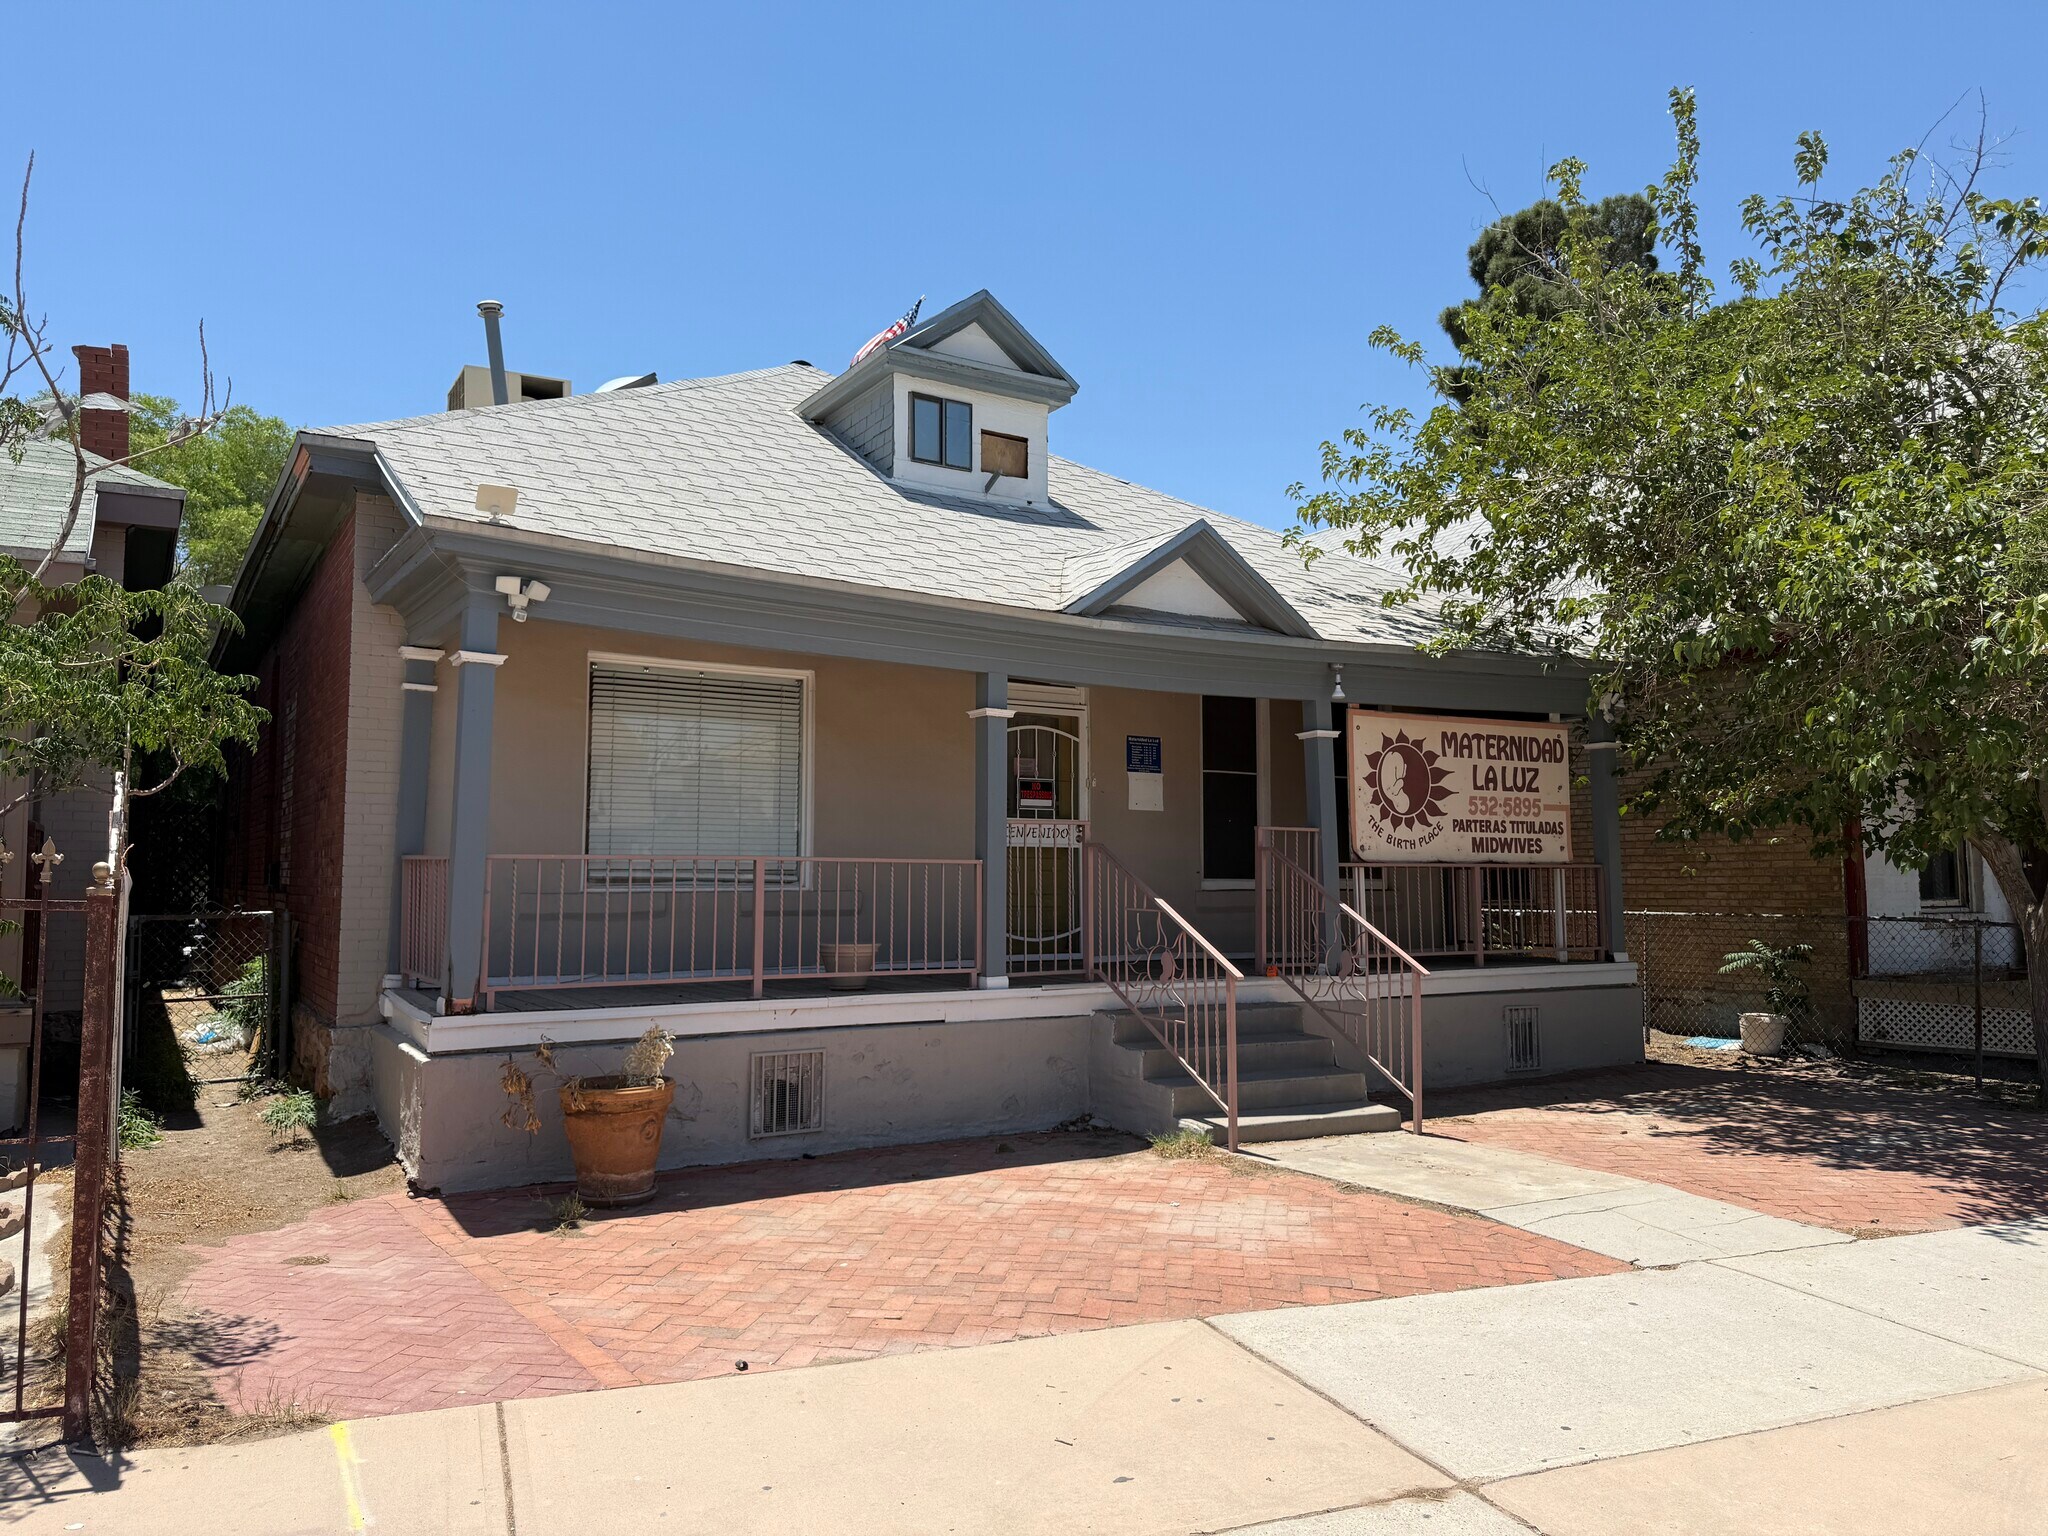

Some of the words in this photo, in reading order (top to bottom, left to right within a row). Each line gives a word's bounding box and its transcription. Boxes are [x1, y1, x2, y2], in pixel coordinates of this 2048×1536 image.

[1440, 731, 1565, 763] MATERNIDAD
[1031, 782, 1041, 791] NO
[1472, 764, 1498, 791] LA
[1501, 766, 1540, 793] LUZ
[1368, 815, 1384, 838] THE
[1386, 832, 1416, 850] BIRTH
[1418, 820, 1444, 848] PLACE
[1452, 818, 1507, 834] PARTERAS
[1509, 820, 1564, 835] TITULADAS
[1471, 837, 1543, 854] MIDWIVES
